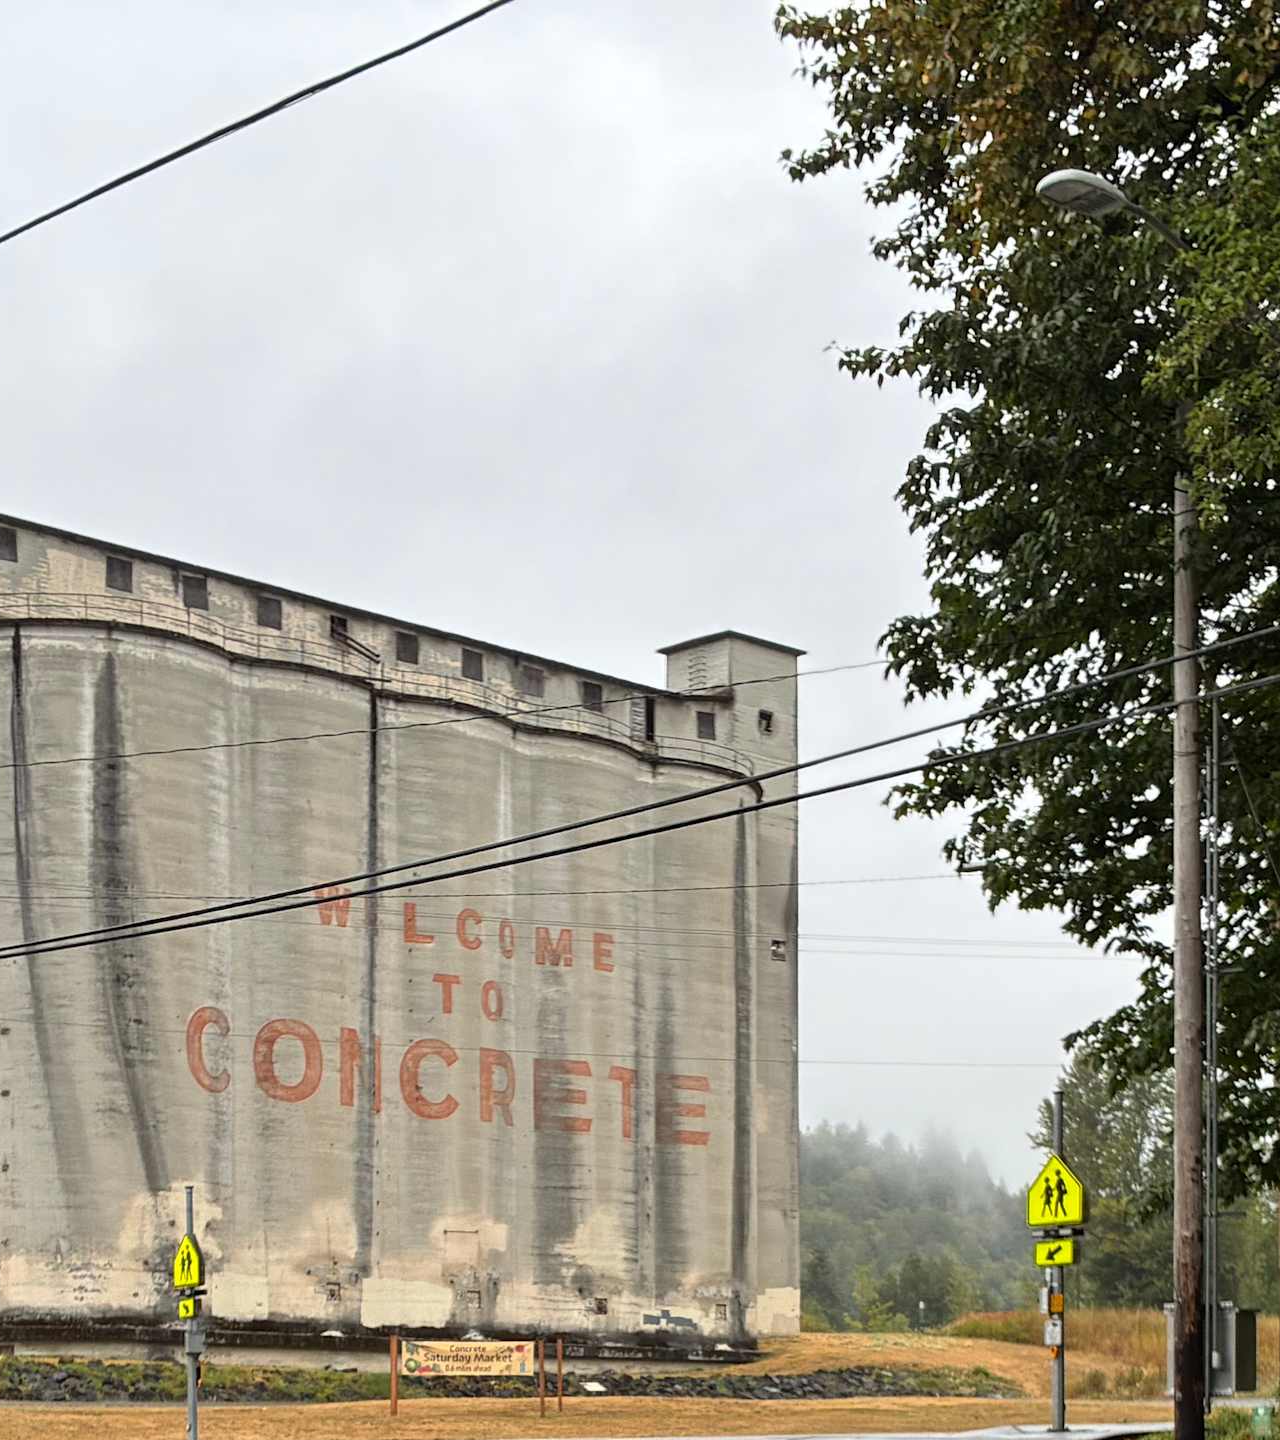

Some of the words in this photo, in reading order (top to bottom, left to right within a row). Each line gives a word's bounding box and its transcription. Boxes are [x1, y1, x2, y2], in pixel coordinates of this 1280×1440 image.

[315, 886, 615, 972] WLCOME
[432, 973, 504, 1022] TO
[186, 1006, 711, 1147] CONCRETE
[423, 1353, 471, 1364] Saturday
[473, 1353, 513, 1363] Market
[449, 1344, 487, 1353] Concrete
